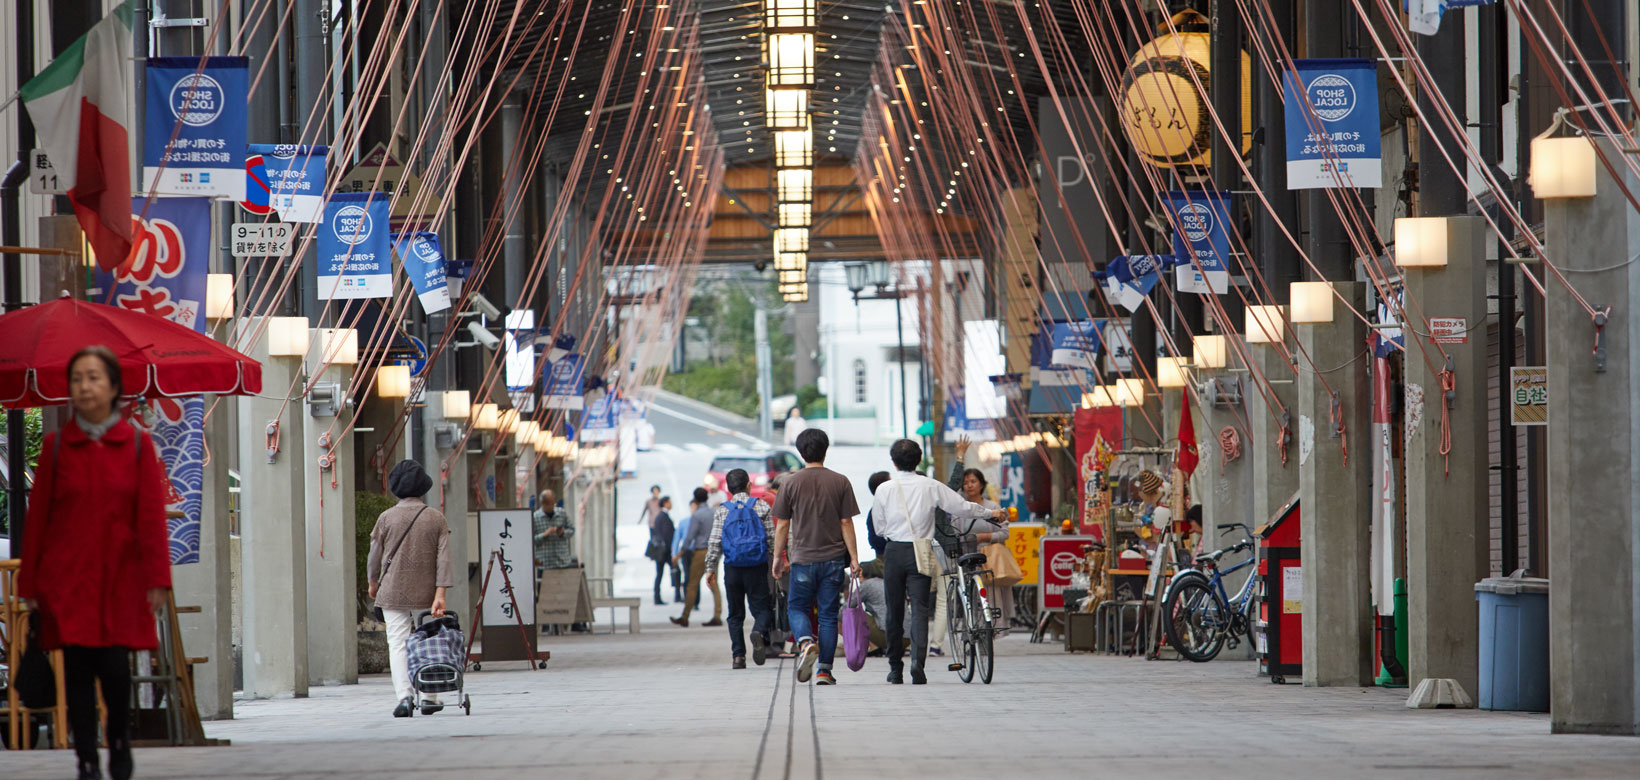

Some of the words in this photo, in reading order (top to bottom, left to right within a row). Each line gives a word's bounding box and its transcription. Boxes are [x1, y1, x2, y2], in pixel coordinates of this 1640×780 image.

[1433, 320, 1465, 328] 防犯カメラ
[1516, 387, 1546, 403] 自社
